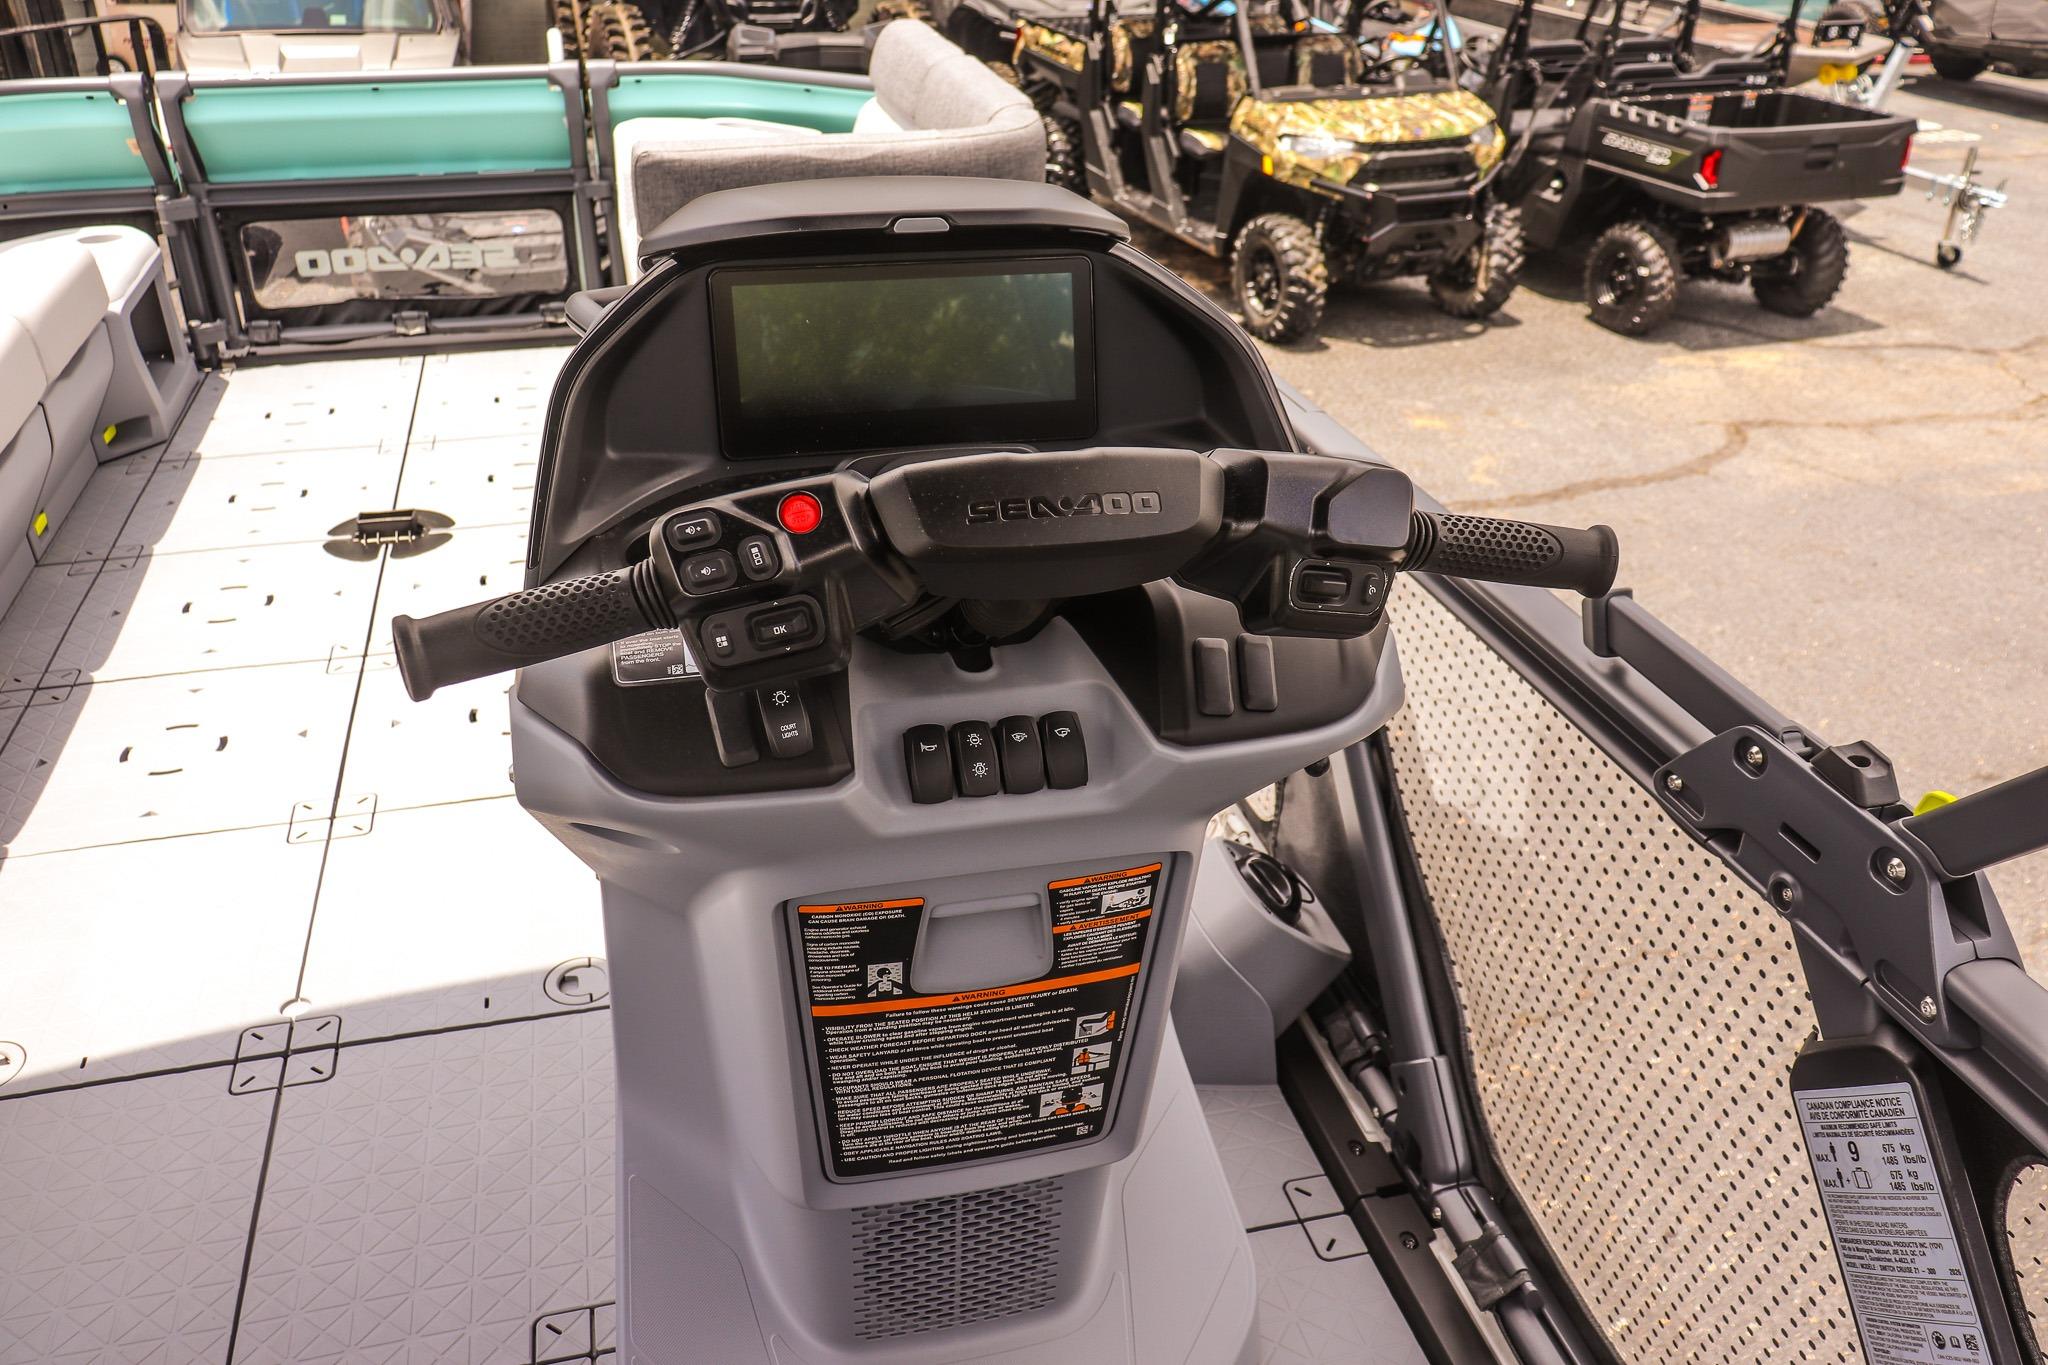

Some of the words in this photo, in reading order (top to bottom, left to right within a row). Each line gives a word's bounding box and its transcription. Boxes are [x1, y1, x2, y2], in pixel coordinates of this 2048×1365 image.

[773, 625, 787, 635] OK
[621, 652, 664, 660] PASSENGERS
[780, 723, 797, 731] COURT
[782, 730, 799, 739] LIGHTS
[1091, 872, 1127, 882] WARNING
[843, 903, 884, 911] WARNING
[1079, 914, 1140, 929] AVERTISSEMENT
[962, 989, 1006, 999] WARNING
[911, 1015, 938, 1023] POSITION
[980, 1006, 1003, 1014] STATION
[849, 1043, 878, 1051] WEATHER
[879, 1040, 910, 1048] FORECAST
[936, 1032, 969, 1041] DEPARTING
[932, 1050, 964, 1059] INFLUENCE
[1805, 1101, 1834, 1110] CANADIAN
[1833, 1099, 1874, 1108] COMPLIANCE
[1874, 1097, 1901, 1106] NOTICE
[1828, 1109, 1868, 1118] CONFORMITÉ
[1868, 1107, 1905, 1116] CANADIEN
[1816, 1154, 1831, 1162] MAX.
[1847, 1141, 1860, 1161] 9
[1882, 1143, 1895, 1152] 675
[1900, 1143, 1911, 1153] kg
[1882, 1156, 1898, 1165] 1485
[1903, 1155, 1926, 1164] lbs/lb
[1890, 1170, 1903, 1180] 675
[1907, 1169, 1918, 1179] kg
[1823, 1179, 1839, 1188] MAX.
[1890, 1182, 1906, 1191] 1485
[1911, 1182, 1934, 1191] lbs/lb
